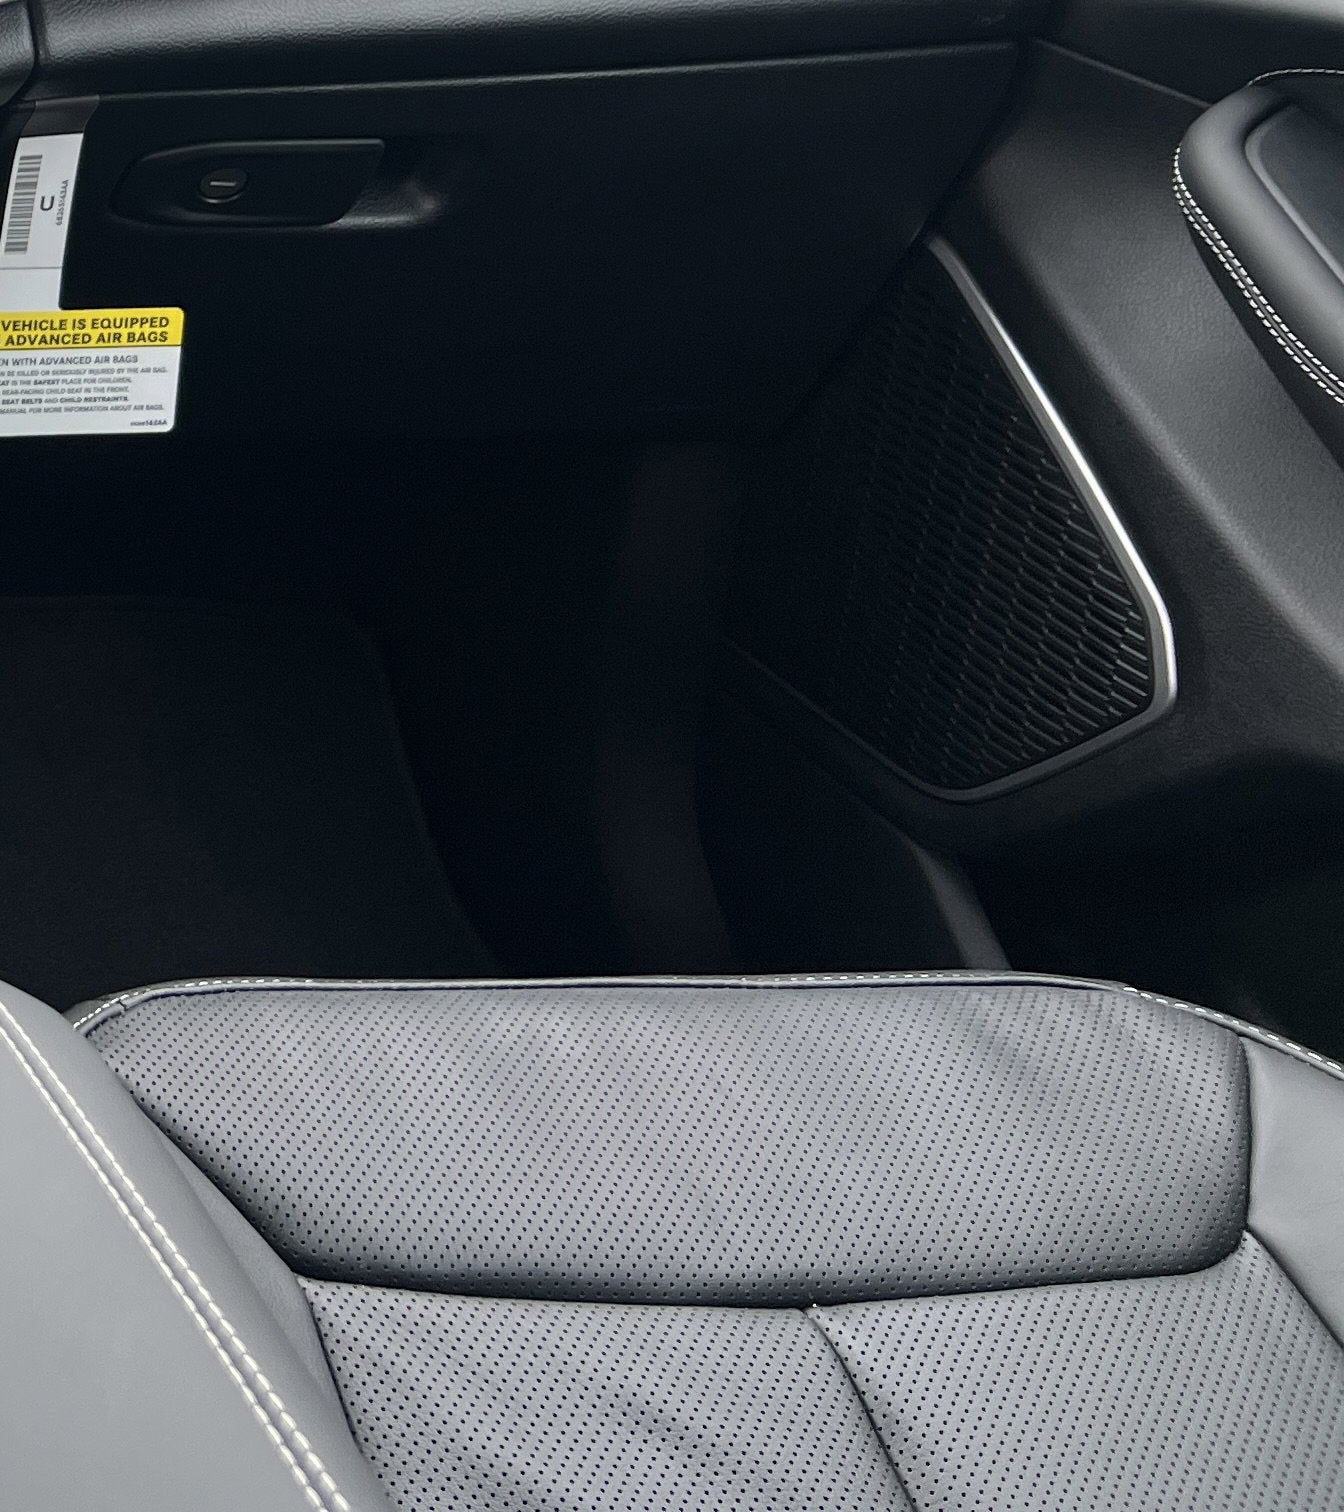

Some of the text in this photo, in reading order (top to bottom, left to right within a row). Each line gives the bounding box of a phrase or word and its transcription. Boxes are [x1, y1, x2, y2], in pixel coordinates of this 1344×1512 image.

[39, 195, 55, 212] U
[1, 319, 68, 332] VEHICLE
[72, 318, 87, 330] IS
[91, 316, 170, 330] EQUIPPED
[5, 333, 92, 346] ADVANCED
[96, 332, 122, 344] AIR
[127, 331, 169, 343] BAGS
[12, 357, 37, 366] WITH
[39, 356, 92, 365] ADVANCED
[94, 355, 111, 364] AIR
[113, 355, 139, 364] BAGS
